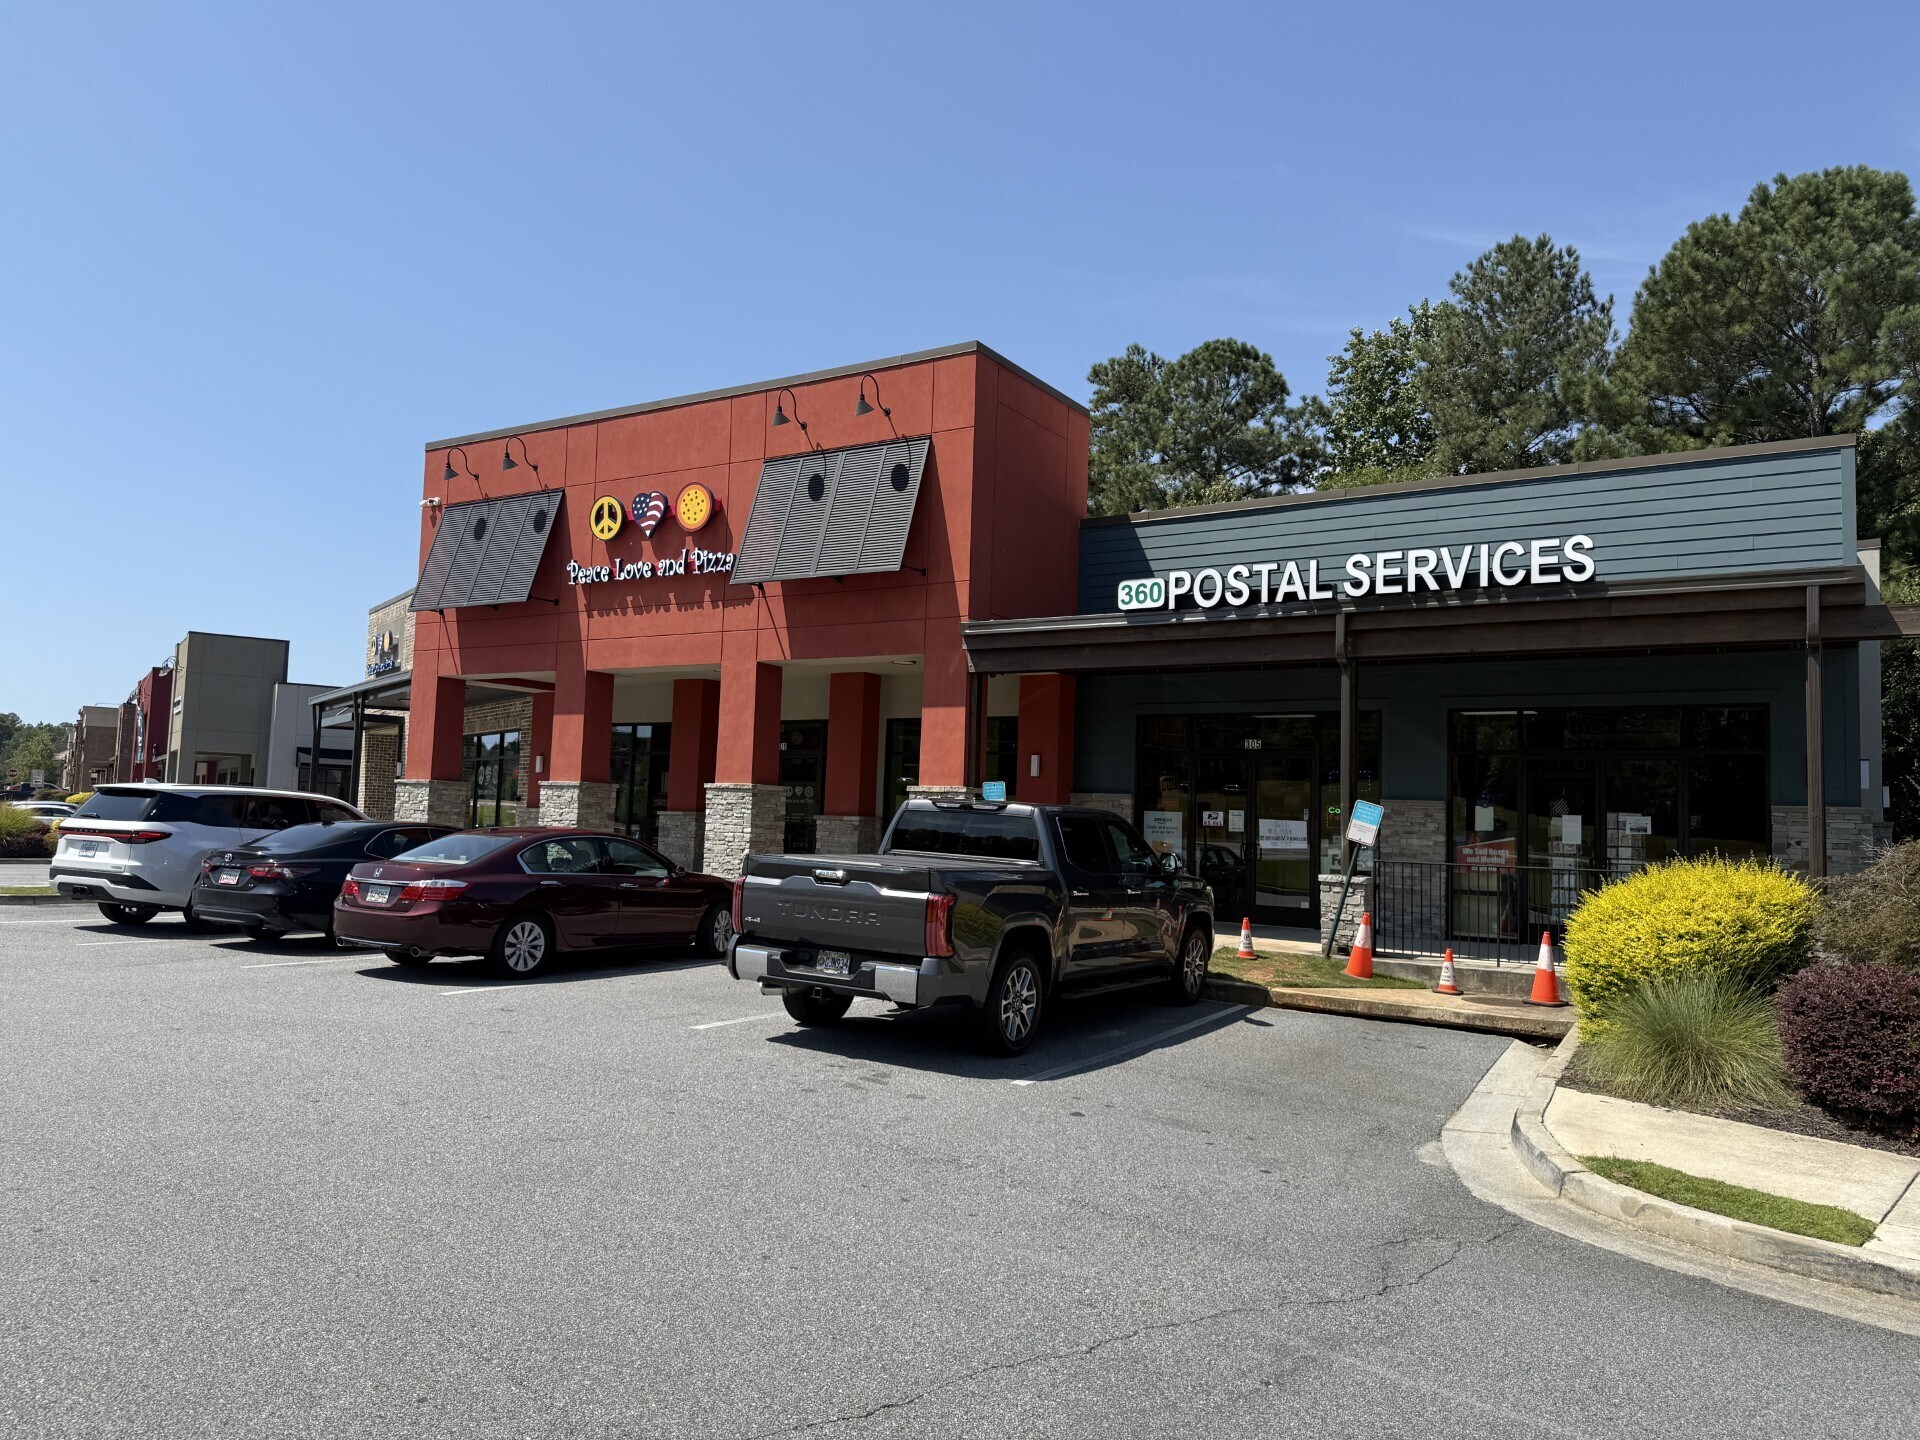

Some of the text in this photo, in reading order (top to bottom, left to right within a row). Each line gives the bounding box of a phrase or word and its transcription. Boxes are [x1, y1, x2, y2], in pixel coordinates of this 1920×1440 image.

[566, 547, 734, 585] Peace Love and Pizza
[1120, 534, 1597, 610] 360 POSTAL SERVICES
[1245, 739, 1262, 749] 305
[1462, 847, 1474, 855] We
[1474, 847, 1488, 855] Sell
[1480, 856, 1506, 865] Moving
[776, 900, 881, 926] TUNDRA
